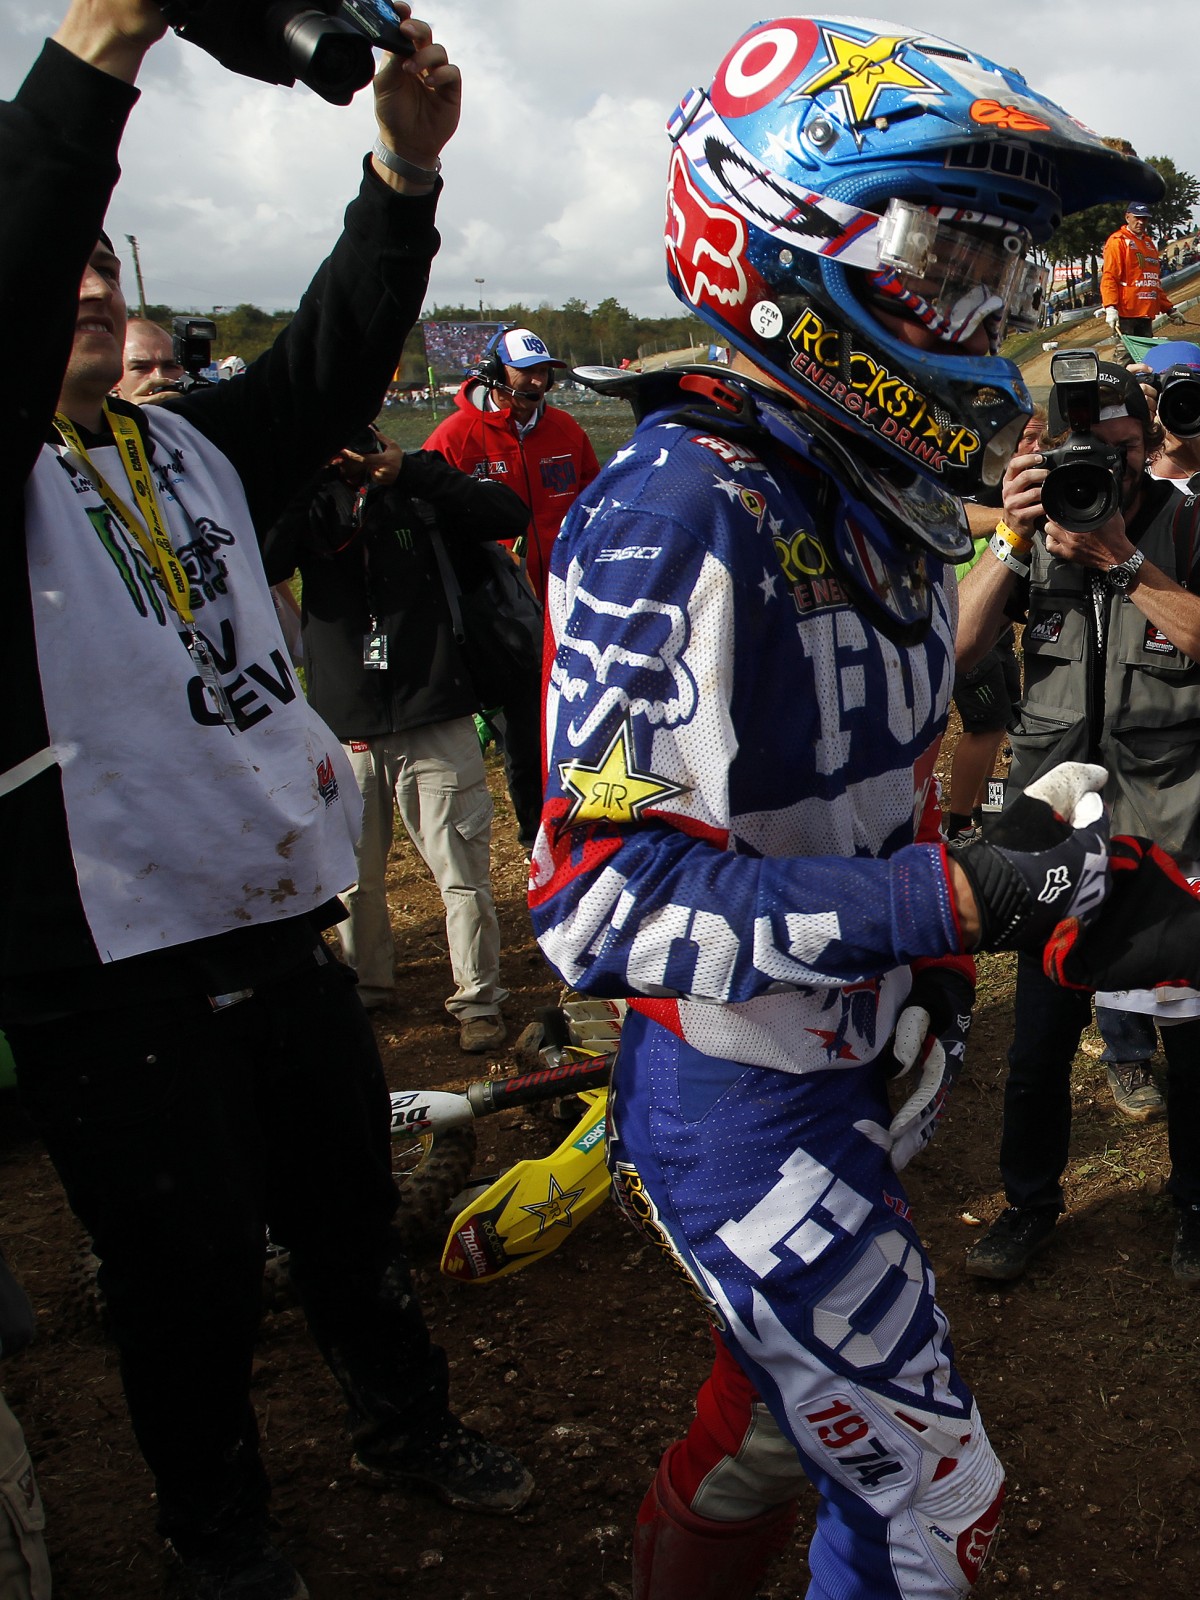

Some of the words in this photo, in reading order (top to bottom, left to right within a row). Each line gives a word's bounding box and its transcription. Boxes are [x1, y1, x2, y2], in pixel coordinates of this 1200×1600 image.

[944, 139, 1062, 193] DUN
[759, 304, 779, 320] FFM
[759, 317, 773, 327] CT
[758, 325, 766, 334] 3
[522, 338, 546, 354] USA
[793, 352, 878, 420] ENERGY
[880, 417, 948, 470] DRINK
[540, 461, 577, 492] USA
[1185, 494, 1197, 507] OS
[186, 648, 296, 736] CEW
[505, 1055, 610, 1094] SHOWA
[805, 1400, 904, 1488] 1974
